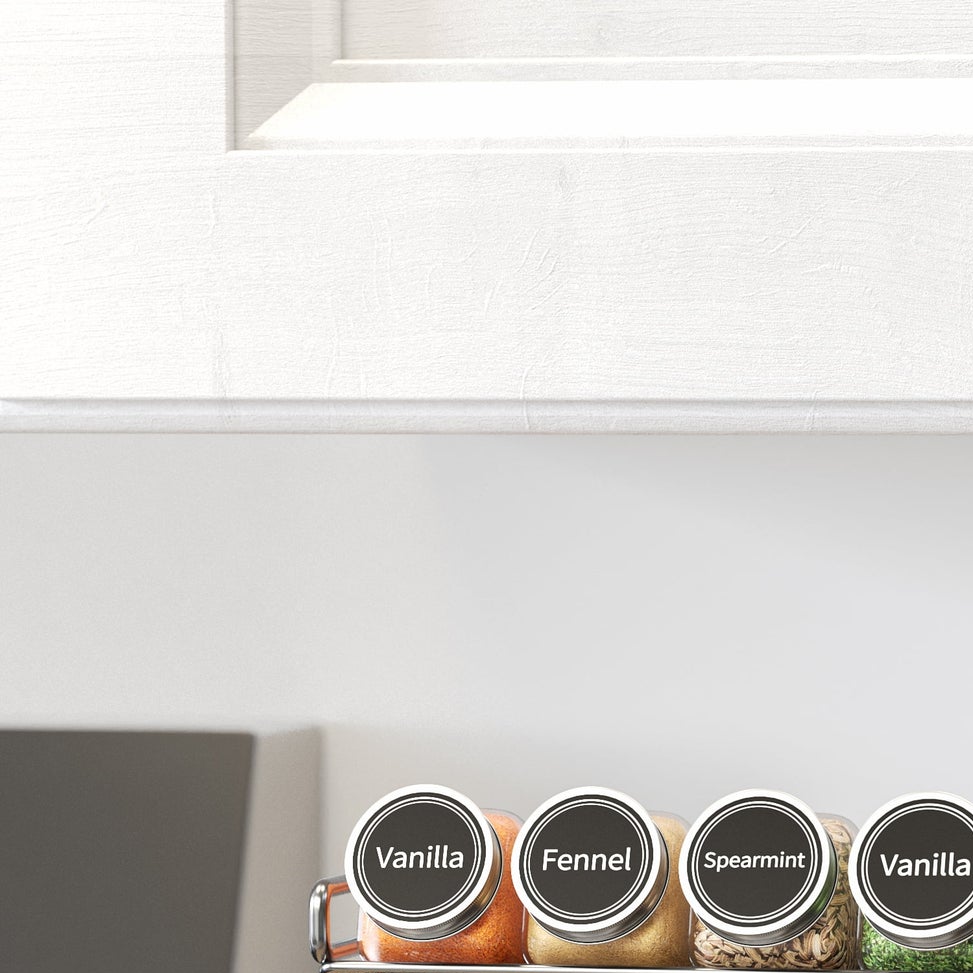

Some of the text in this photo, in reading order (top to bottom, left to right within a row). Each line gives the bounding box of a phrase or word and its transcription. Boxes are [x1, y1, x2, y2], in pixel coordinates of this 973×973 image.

[375, 844, 464, 869] Vanilla
[542, 846, 632, 872] Fennel
[703, 850, 806, 873] Spearmint
[879, 851, 971, 877] Vanilla
